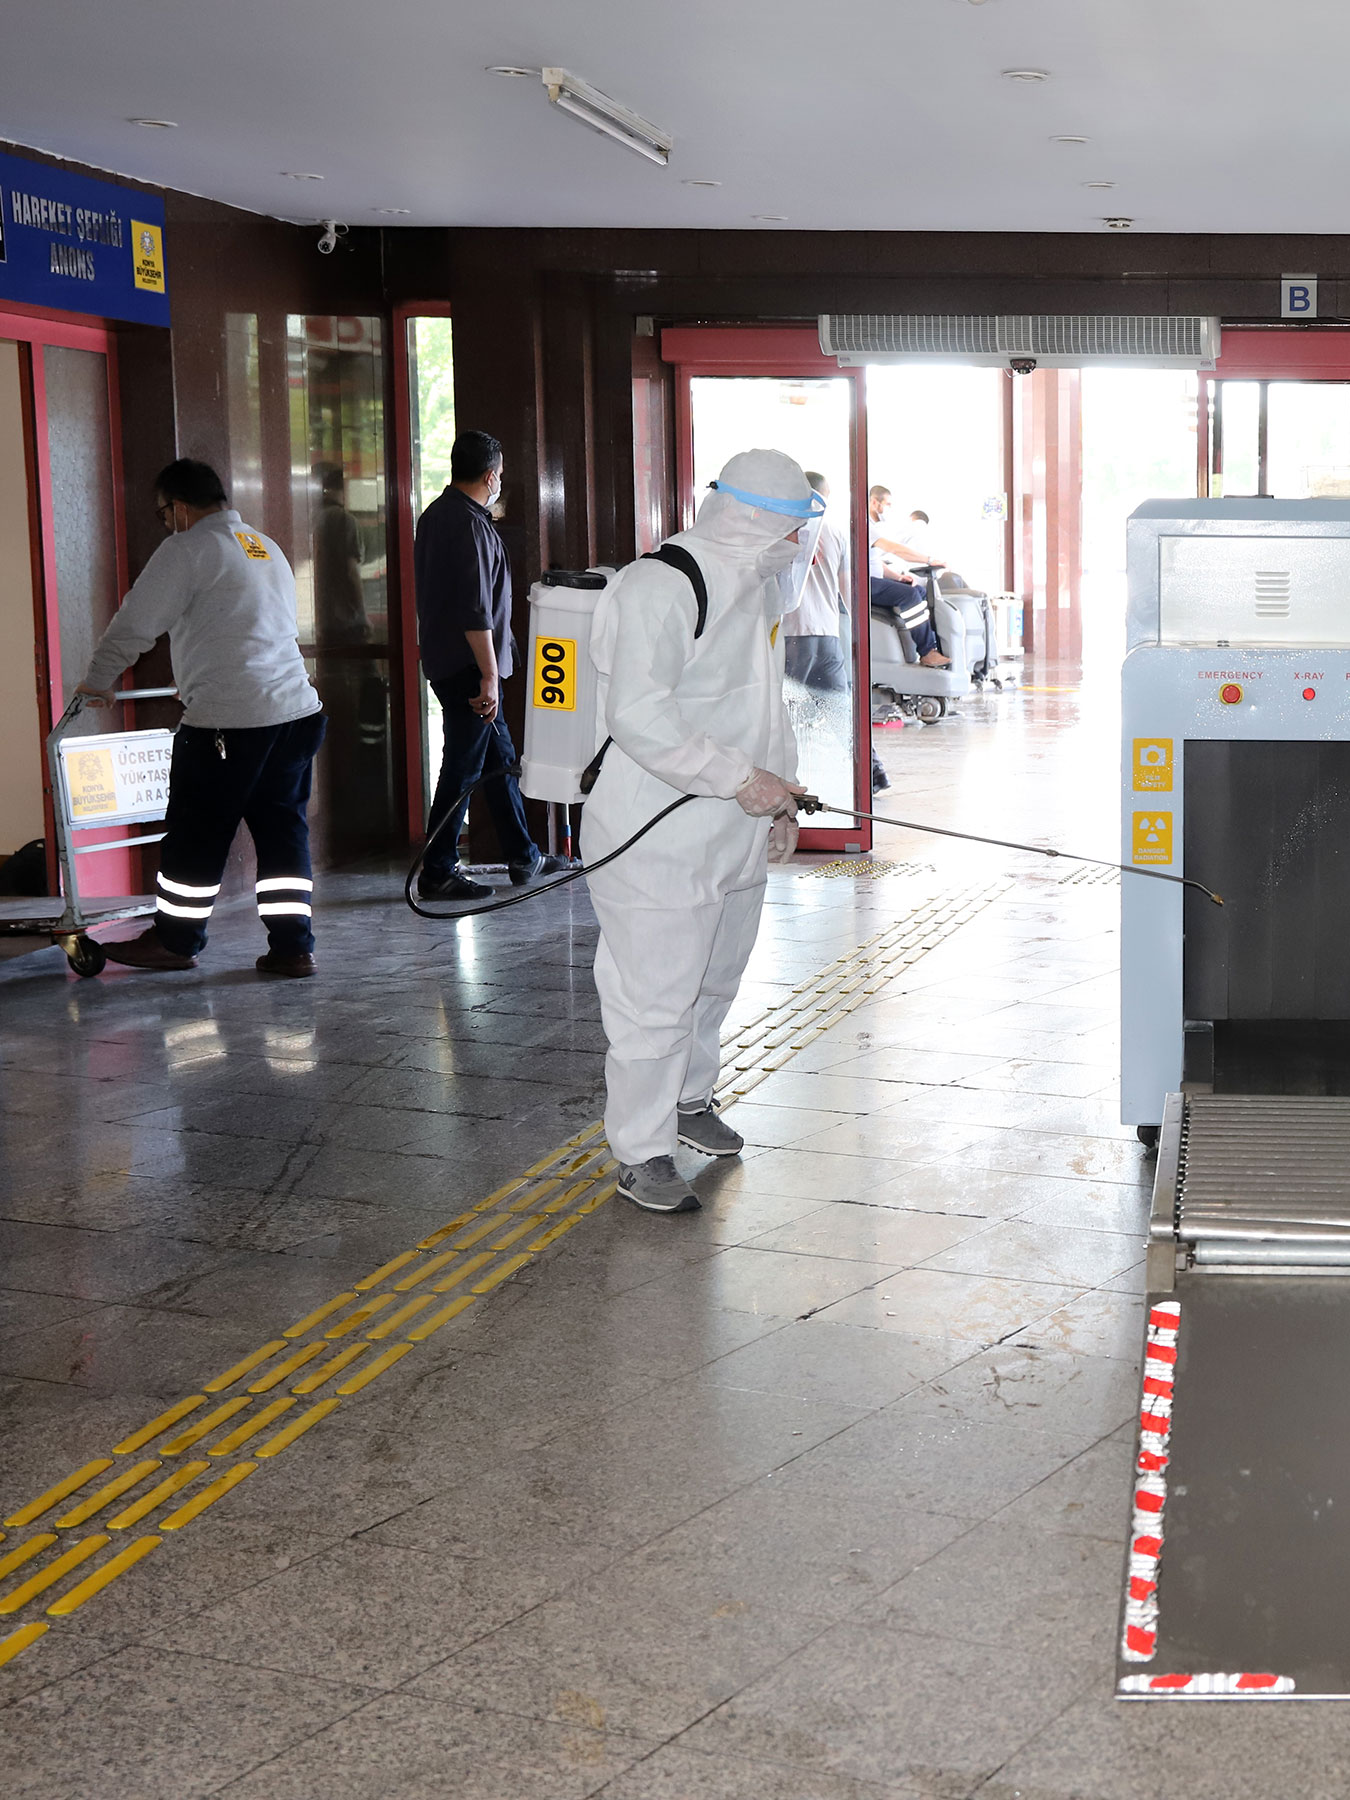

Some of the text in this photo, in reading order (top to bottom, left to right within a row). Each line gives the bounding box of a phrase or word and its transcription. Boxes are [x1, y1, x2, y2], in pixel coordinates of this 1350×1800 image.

[12, 191, 73, 236] HAREKET
[51, 243, 96, 281] ANONS
[1289, 286, 1311, 312] B
[541, 642, 566, 704] 900
[1198, 671, 1264, 680] EMERGENCY
[1294, 672, 1324, 681] X-RAY
